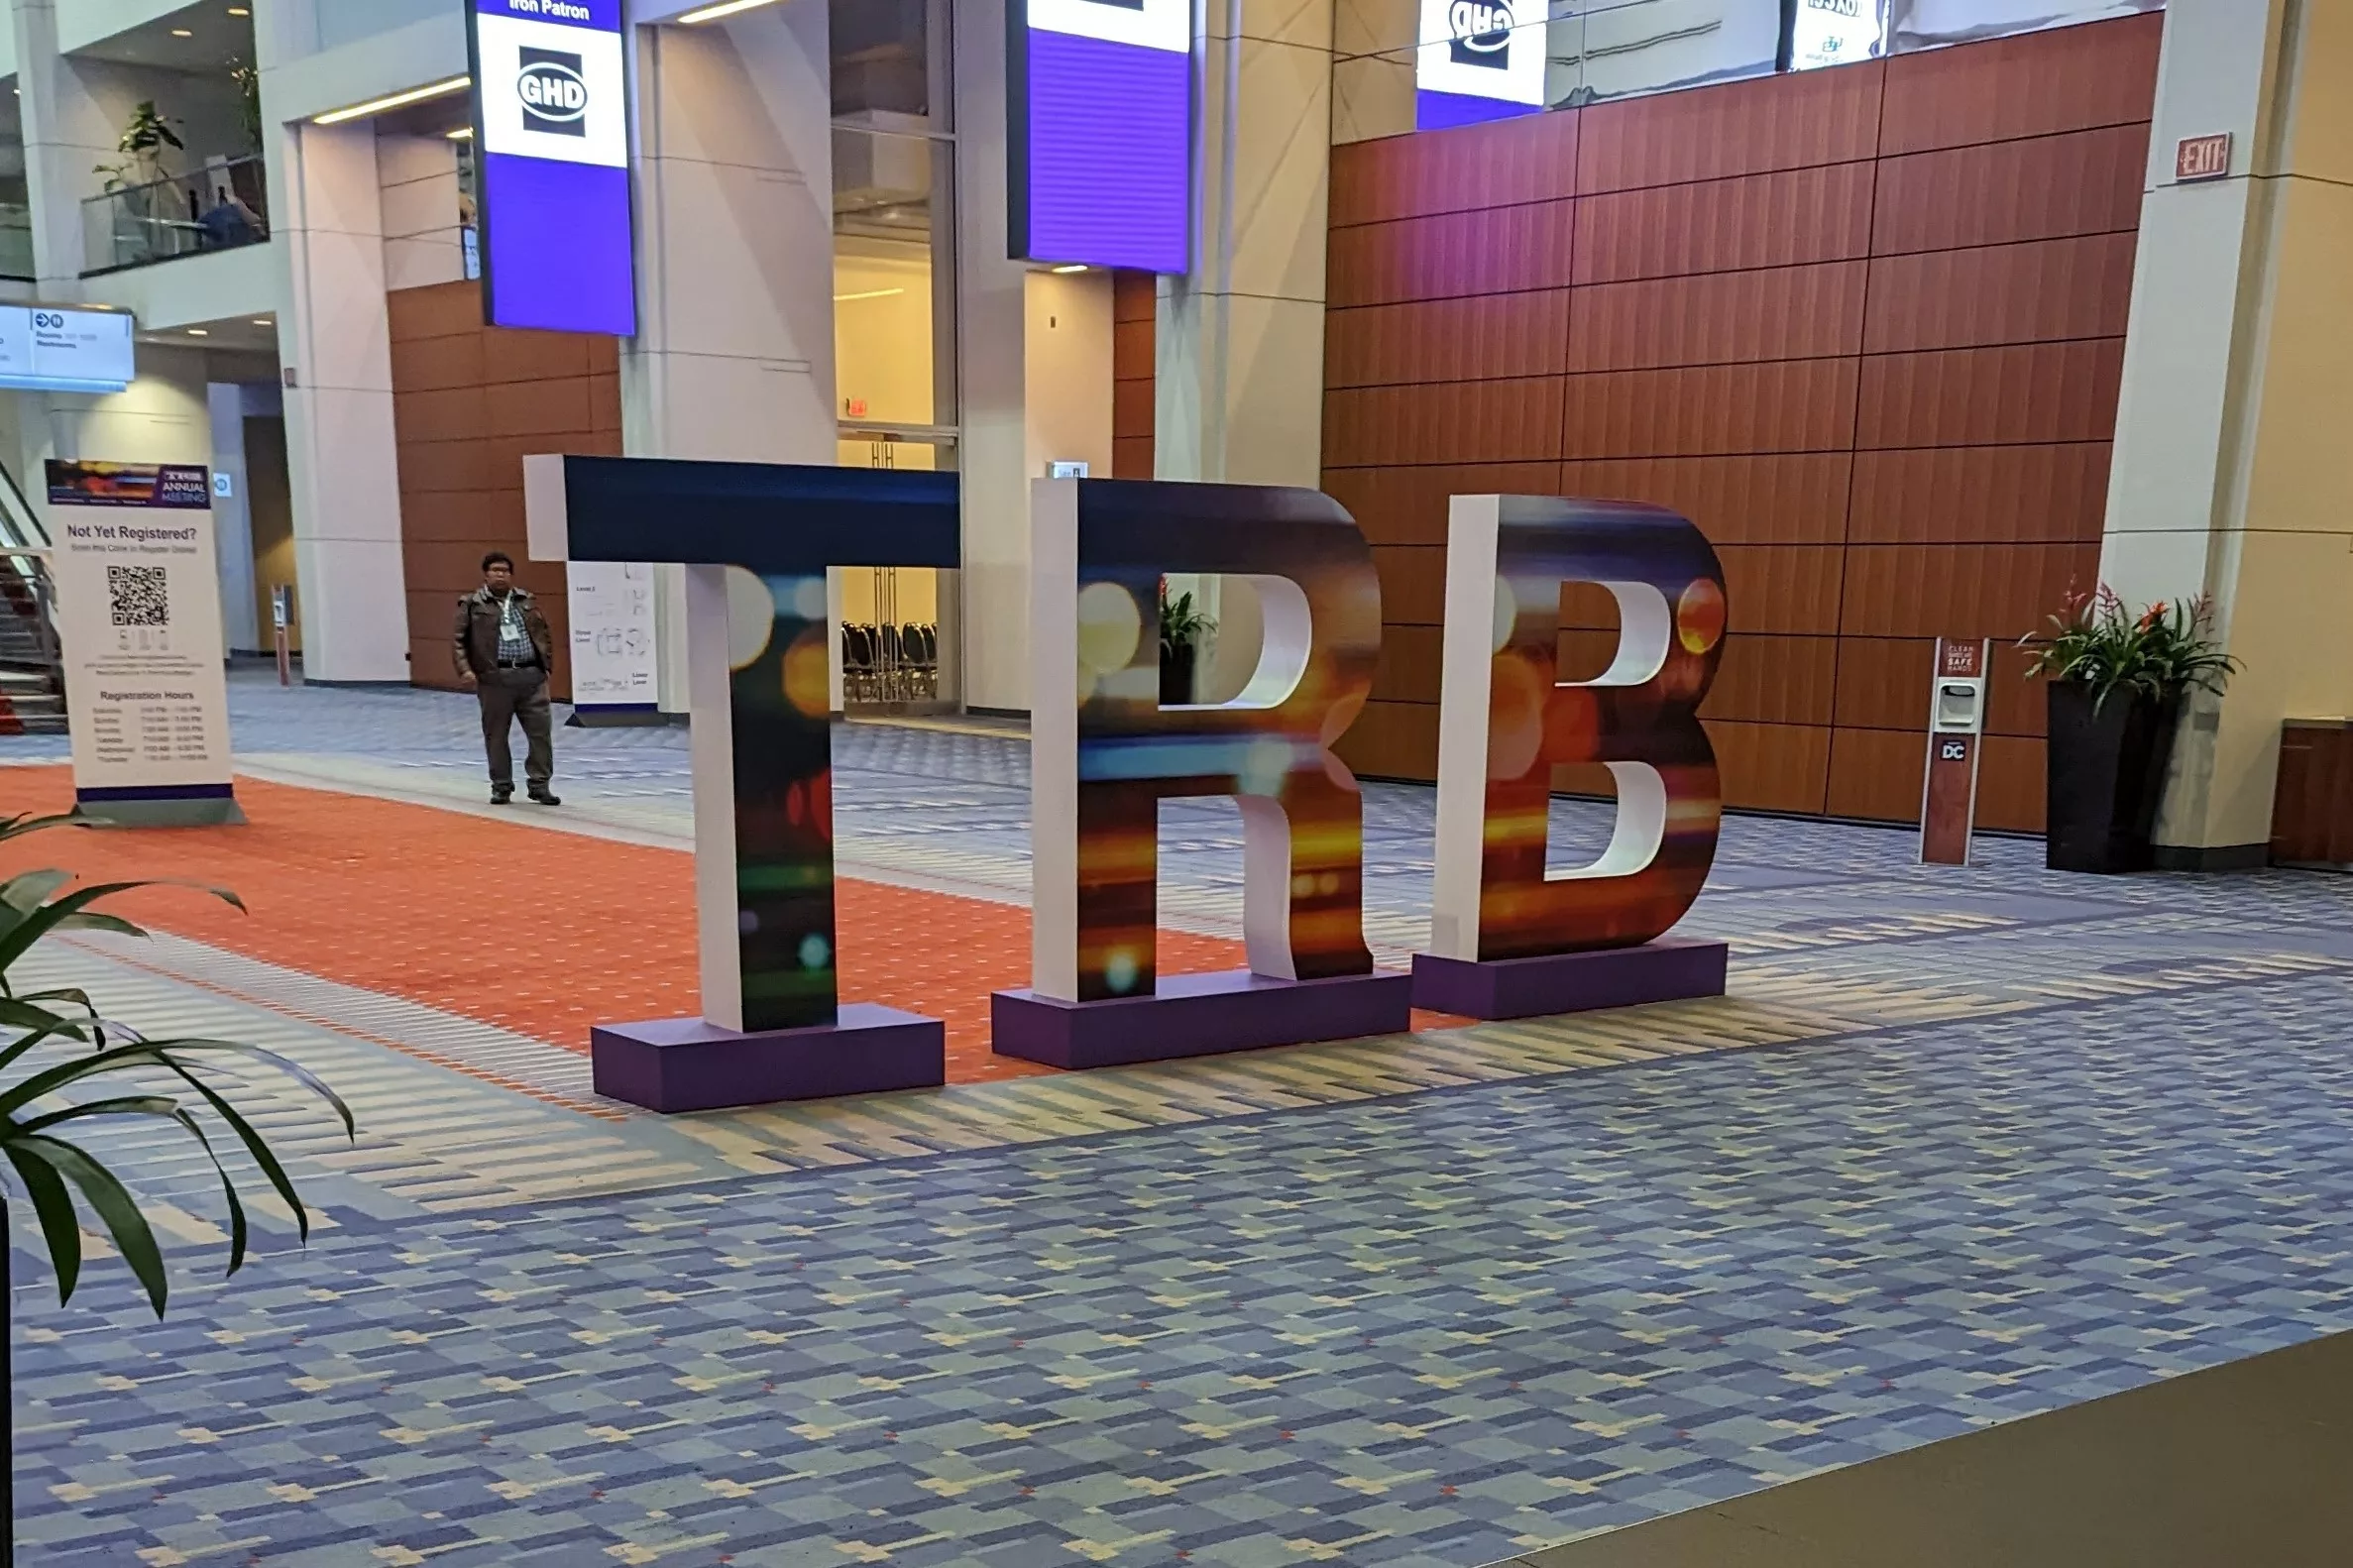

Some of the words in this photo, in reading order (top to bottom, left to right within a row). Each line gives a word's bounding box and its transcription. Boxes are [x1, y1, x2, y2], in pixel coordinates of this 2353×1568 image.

[508, 0, 539, 13] Iron
[541, 0, 590, 20] Patron
[520, 74, 585, 109] GHD
[2184, 138, 2224, 173] EXIT
[162, 482, 206, 493] ANNUAL
[67, 524, 90, 538] Not
[93, 525, 116, 538] Yet
[119, 526, 197, 541] Registered?
[1948, 657, 1972, 666] SAFE
[100, 691, 162, 701] Registration
[165, 691, 194, 700] Hours
[523, 454, 1729, 1032] TRB
[1942, 744, 1964, 759] DC
